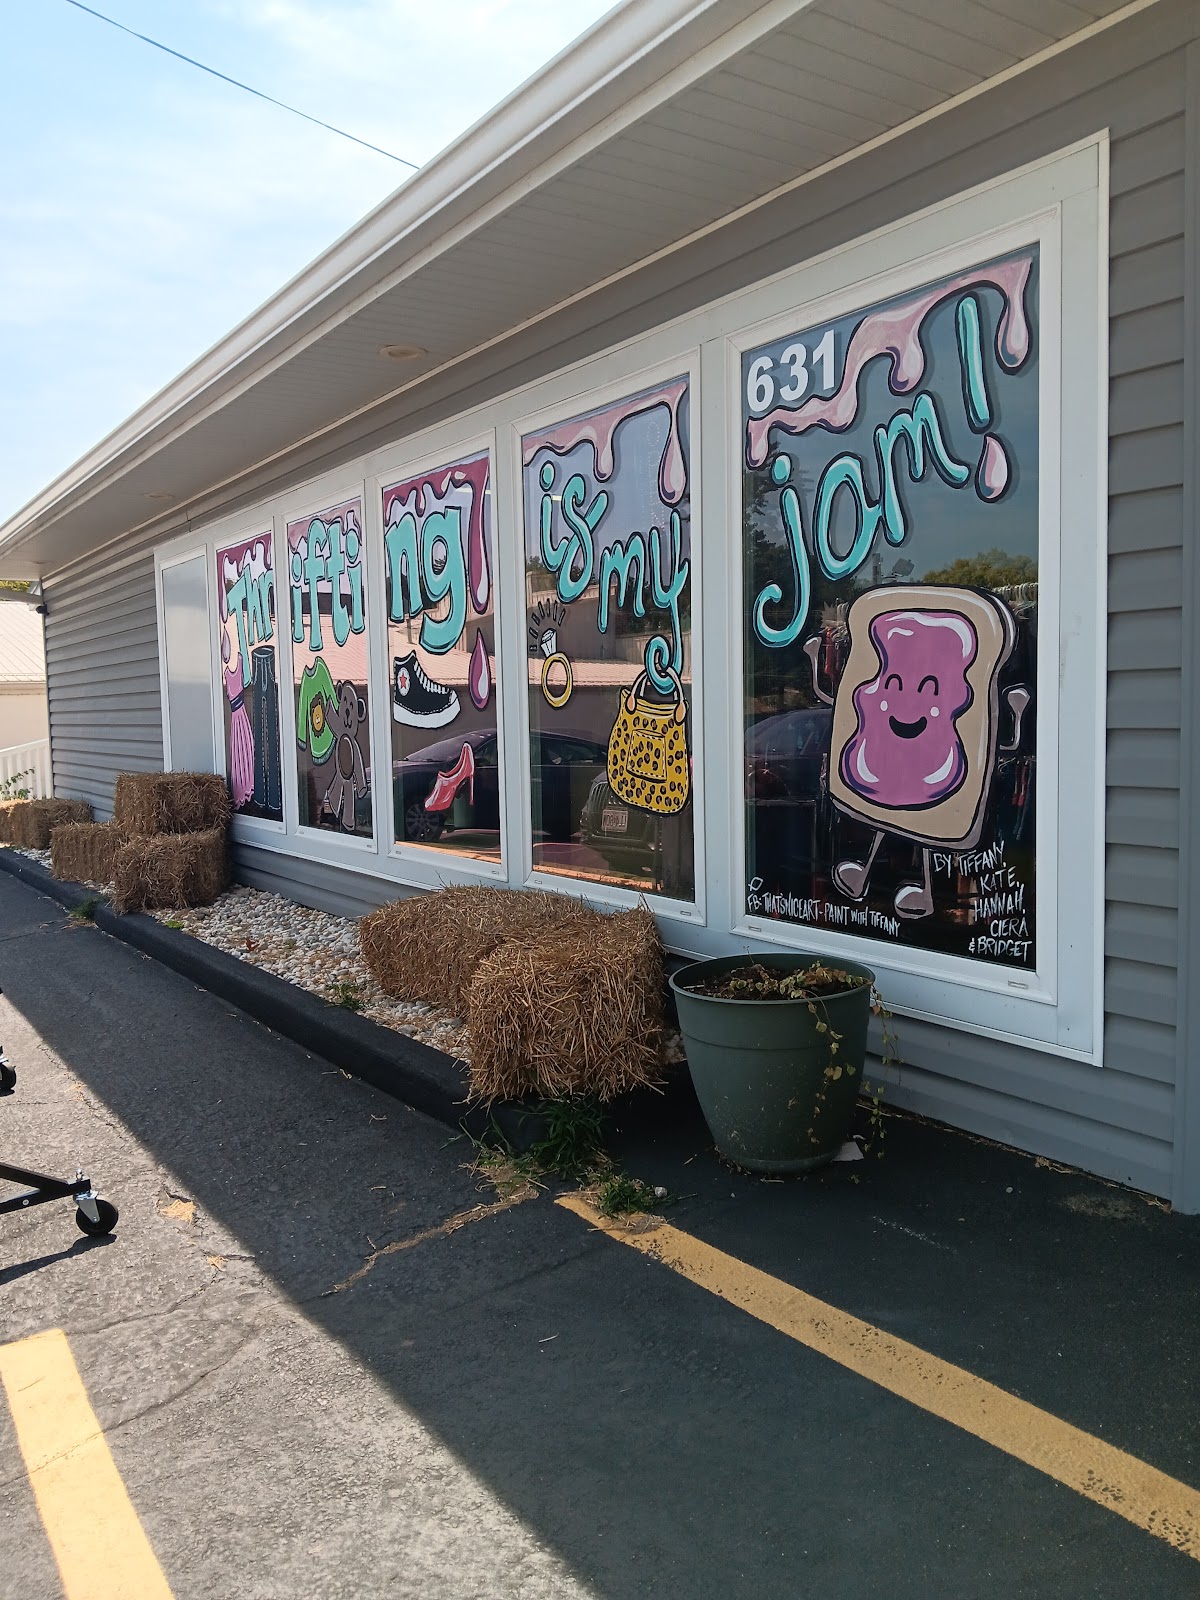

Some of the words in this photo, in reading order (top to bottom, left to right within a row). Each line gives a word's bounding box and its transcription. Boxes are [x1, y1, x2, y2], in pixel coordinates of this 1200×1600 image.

[746, 329, 836, 414] 631
[540, 460, 608, 604] is
[597, 507, 690, 695] my
[933, 853, 952, 878] BY
[990, 917, 1029, 938] CIERA
